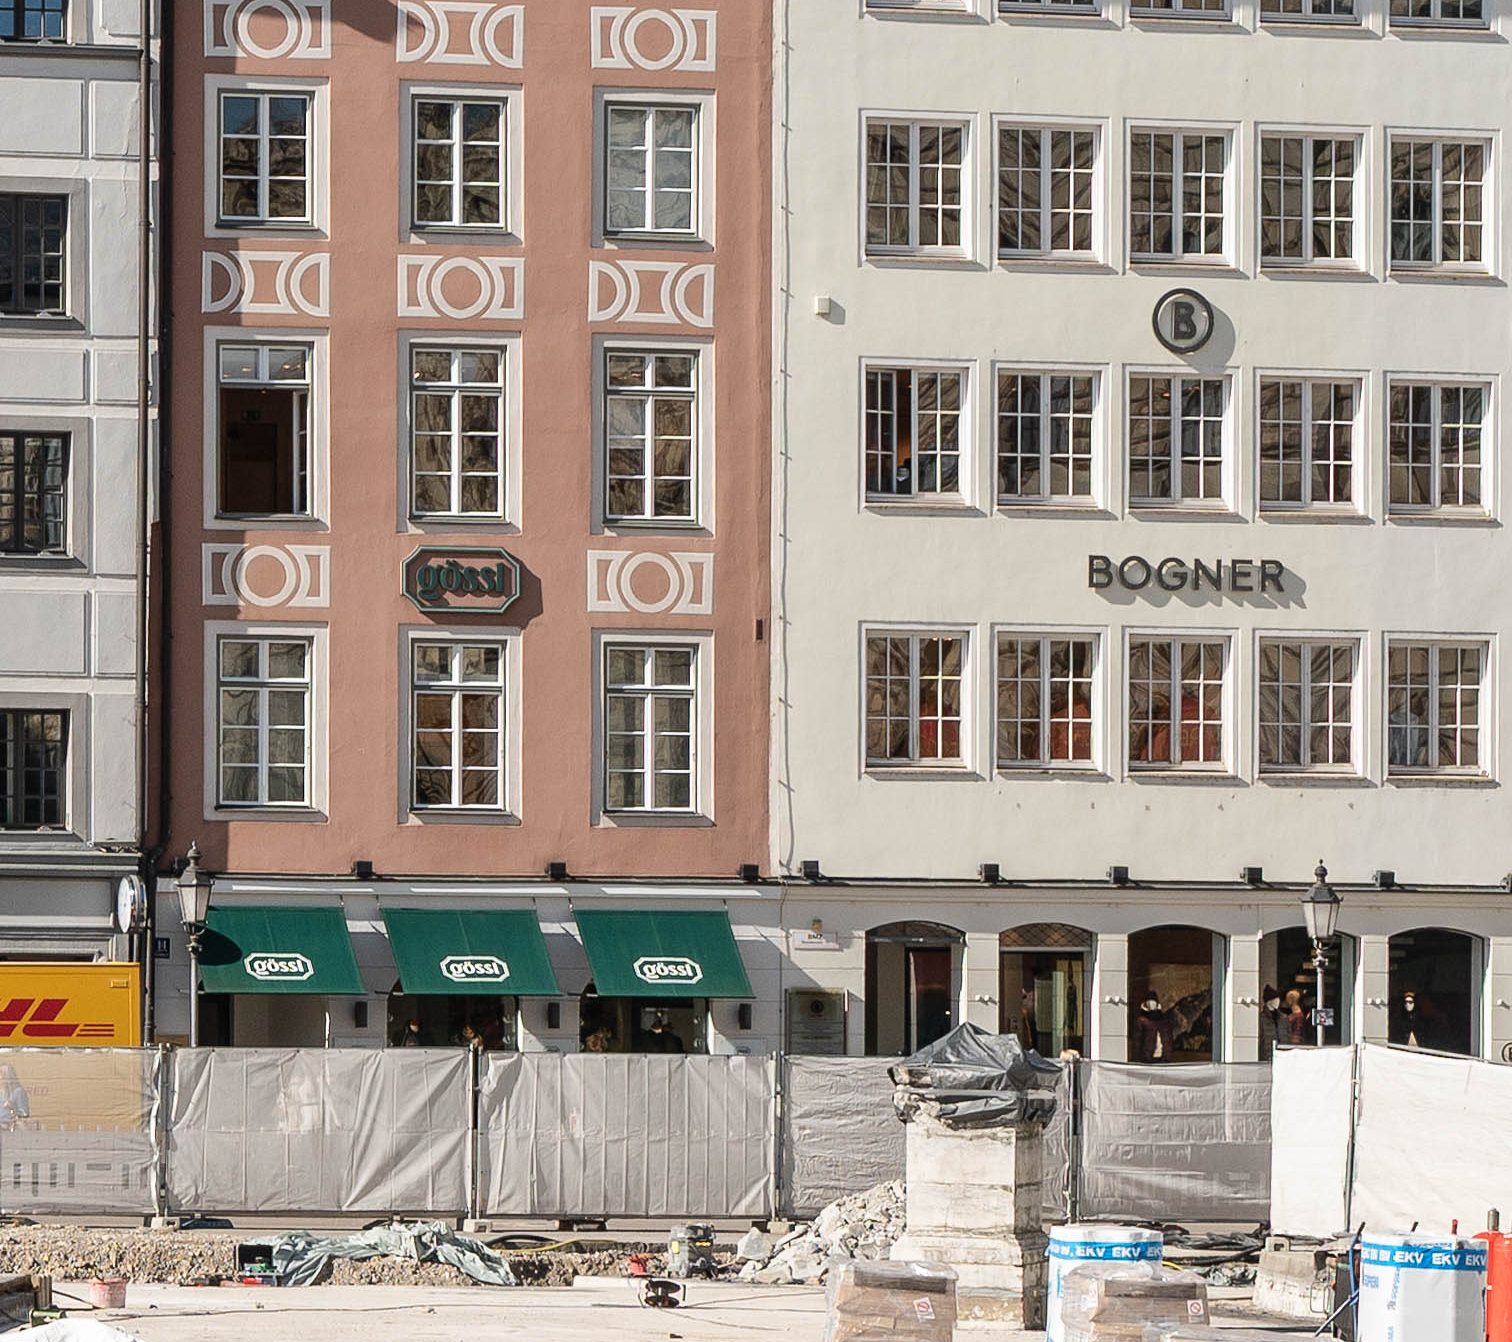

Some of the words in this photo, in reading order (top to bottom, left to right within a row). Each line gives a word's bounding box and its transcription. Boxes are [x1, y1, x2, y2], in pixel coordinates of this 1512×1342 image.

[416, 560, 506, 599] gössl
[1086, 554, 1285, 593] BOGNER
[254, 960, 304, 975] gössl
[450, 962, 500, 978] gössl
[644, 964, 693, 979] gössl
[1112, 1246, 1141, 1258] EKV
[1432, 1252, 1461, 1265] EKV
